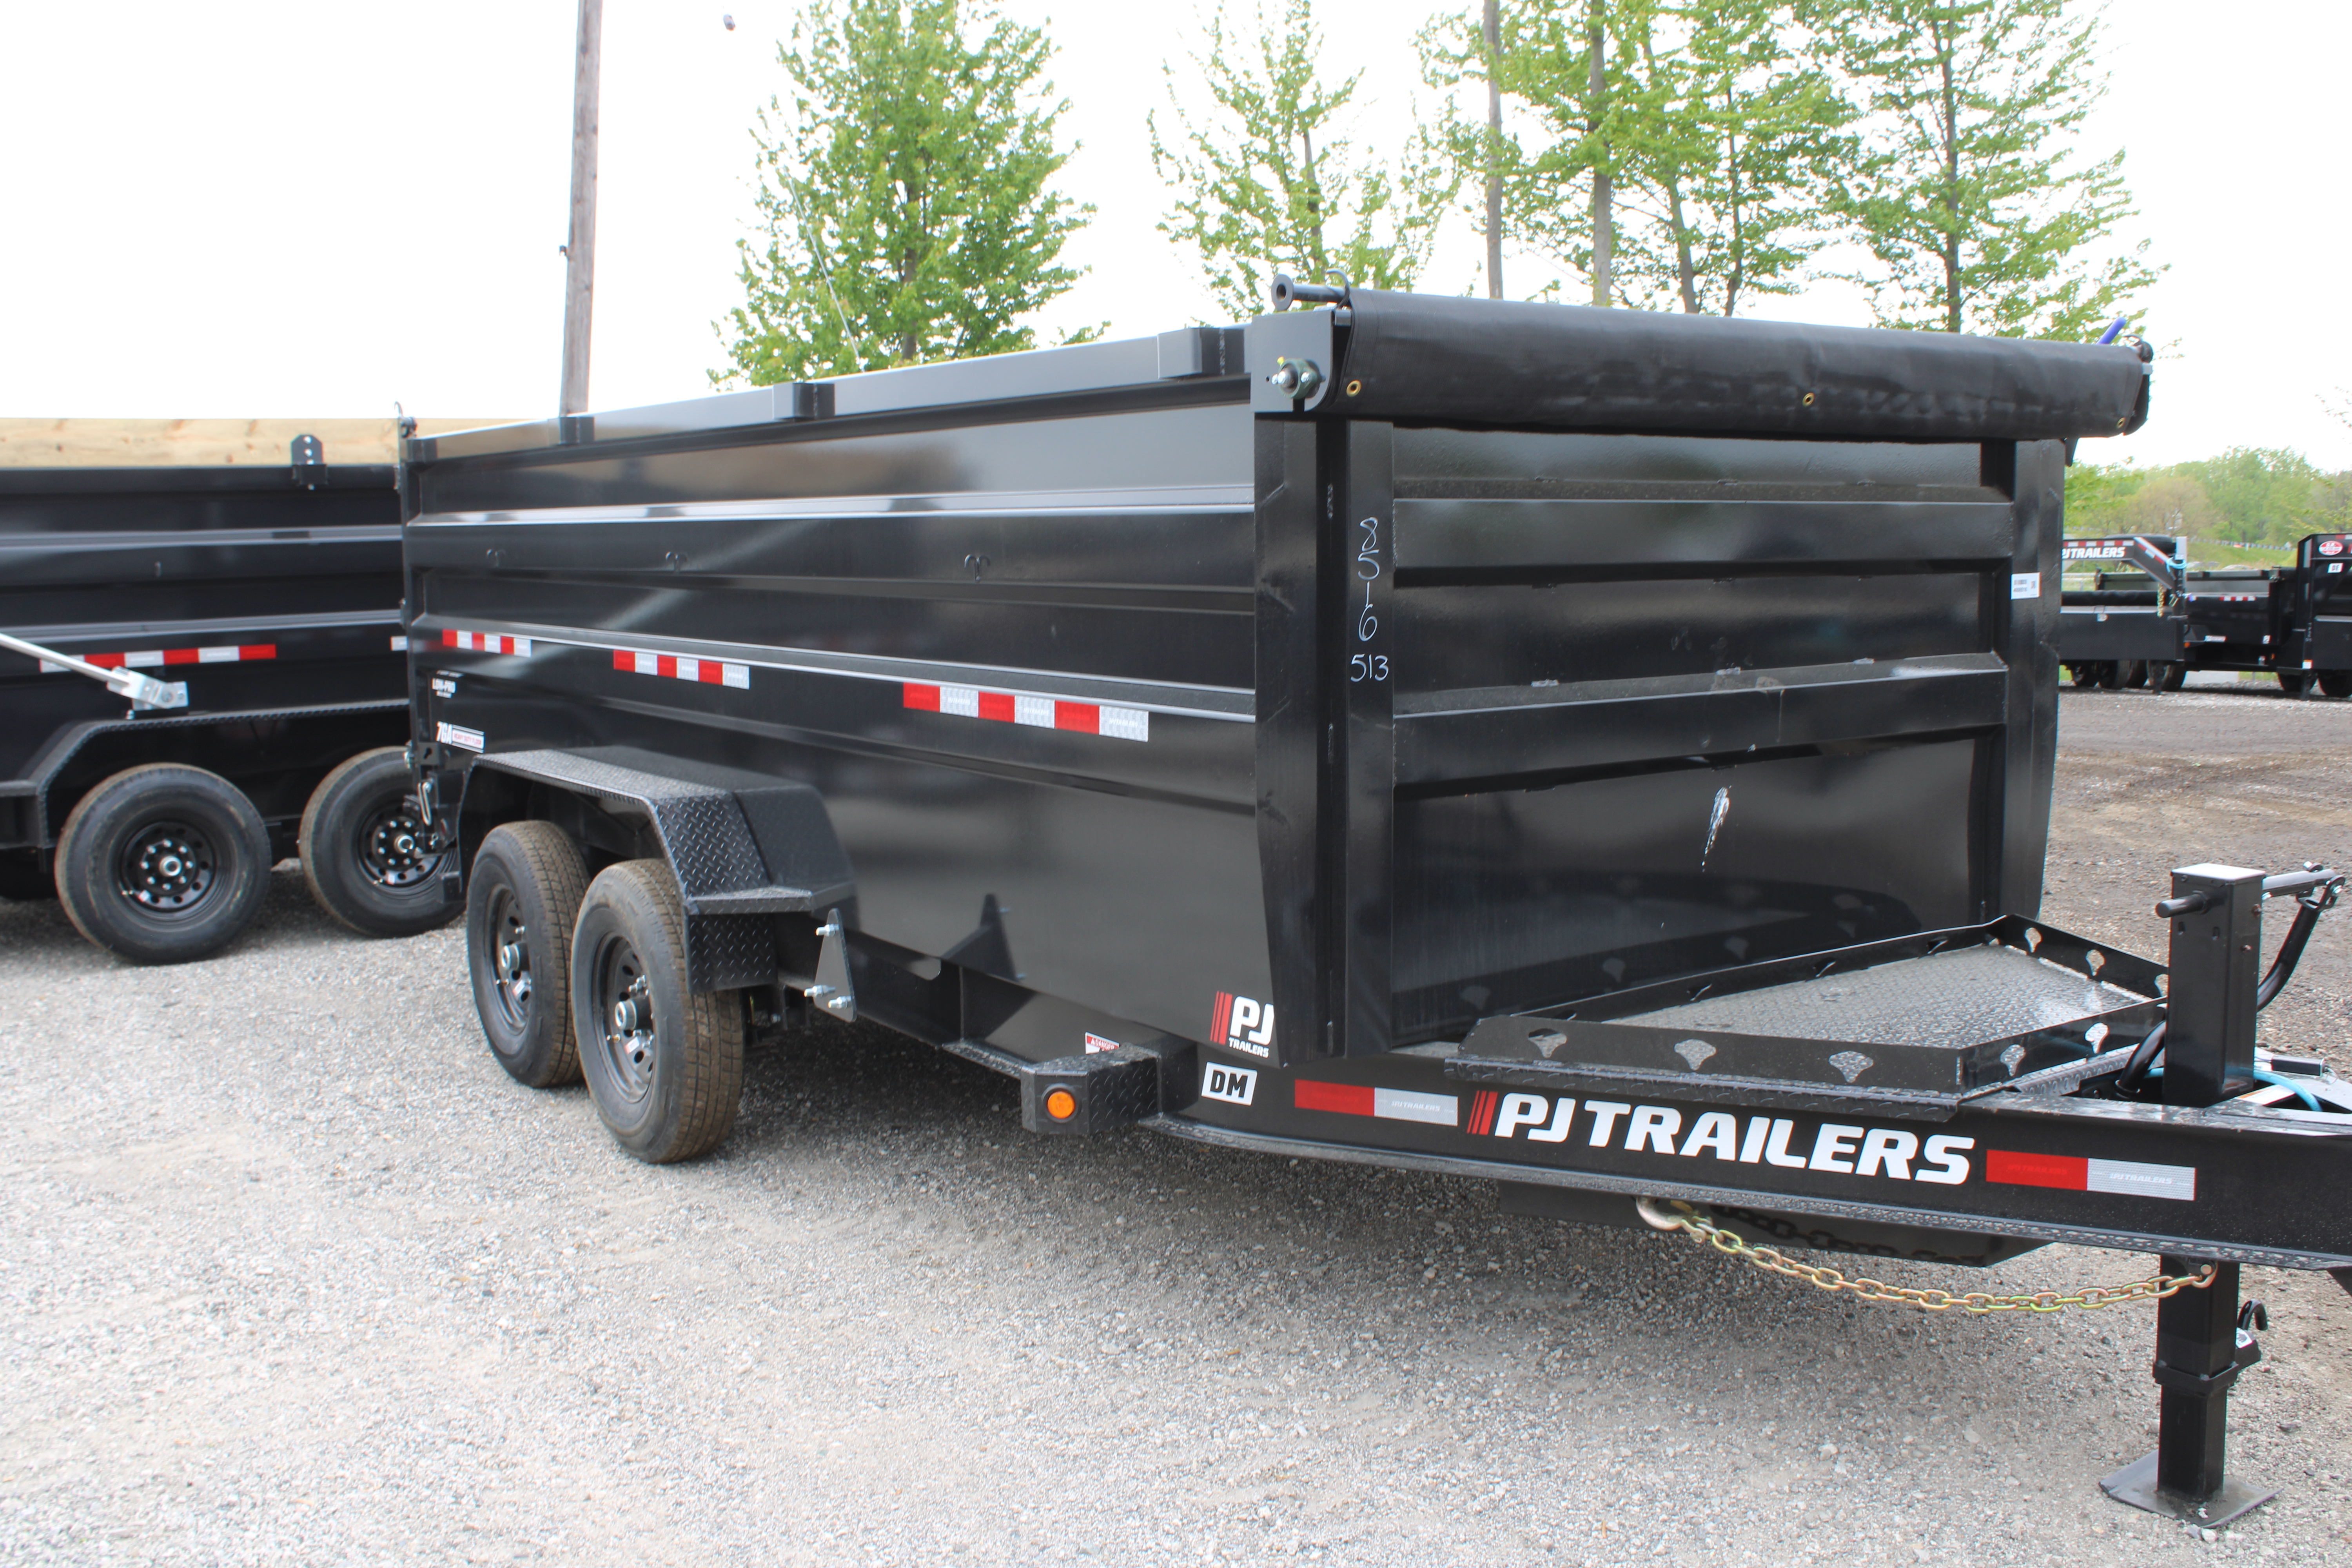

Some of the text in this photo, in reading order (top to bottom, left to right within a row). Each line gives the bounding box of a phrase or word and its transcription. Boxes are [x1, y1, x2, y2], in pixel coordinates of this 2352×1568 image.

[2071, 547, 2126, 559] TRAILERS
[1350, 654, 1389, 682] 513
[1230, 996, 1274, 1046] PJ
[1095, 1039, 1115, 1050] DANGER
[1229, 1037, 1269, 1058] TRAILERS
[1210, 1070, 1249, 1099] DM
[1494, 1092, 1976, 1185] PJ TRAILERS
[2125, 1174, 2173, 1185] TRAILERS
